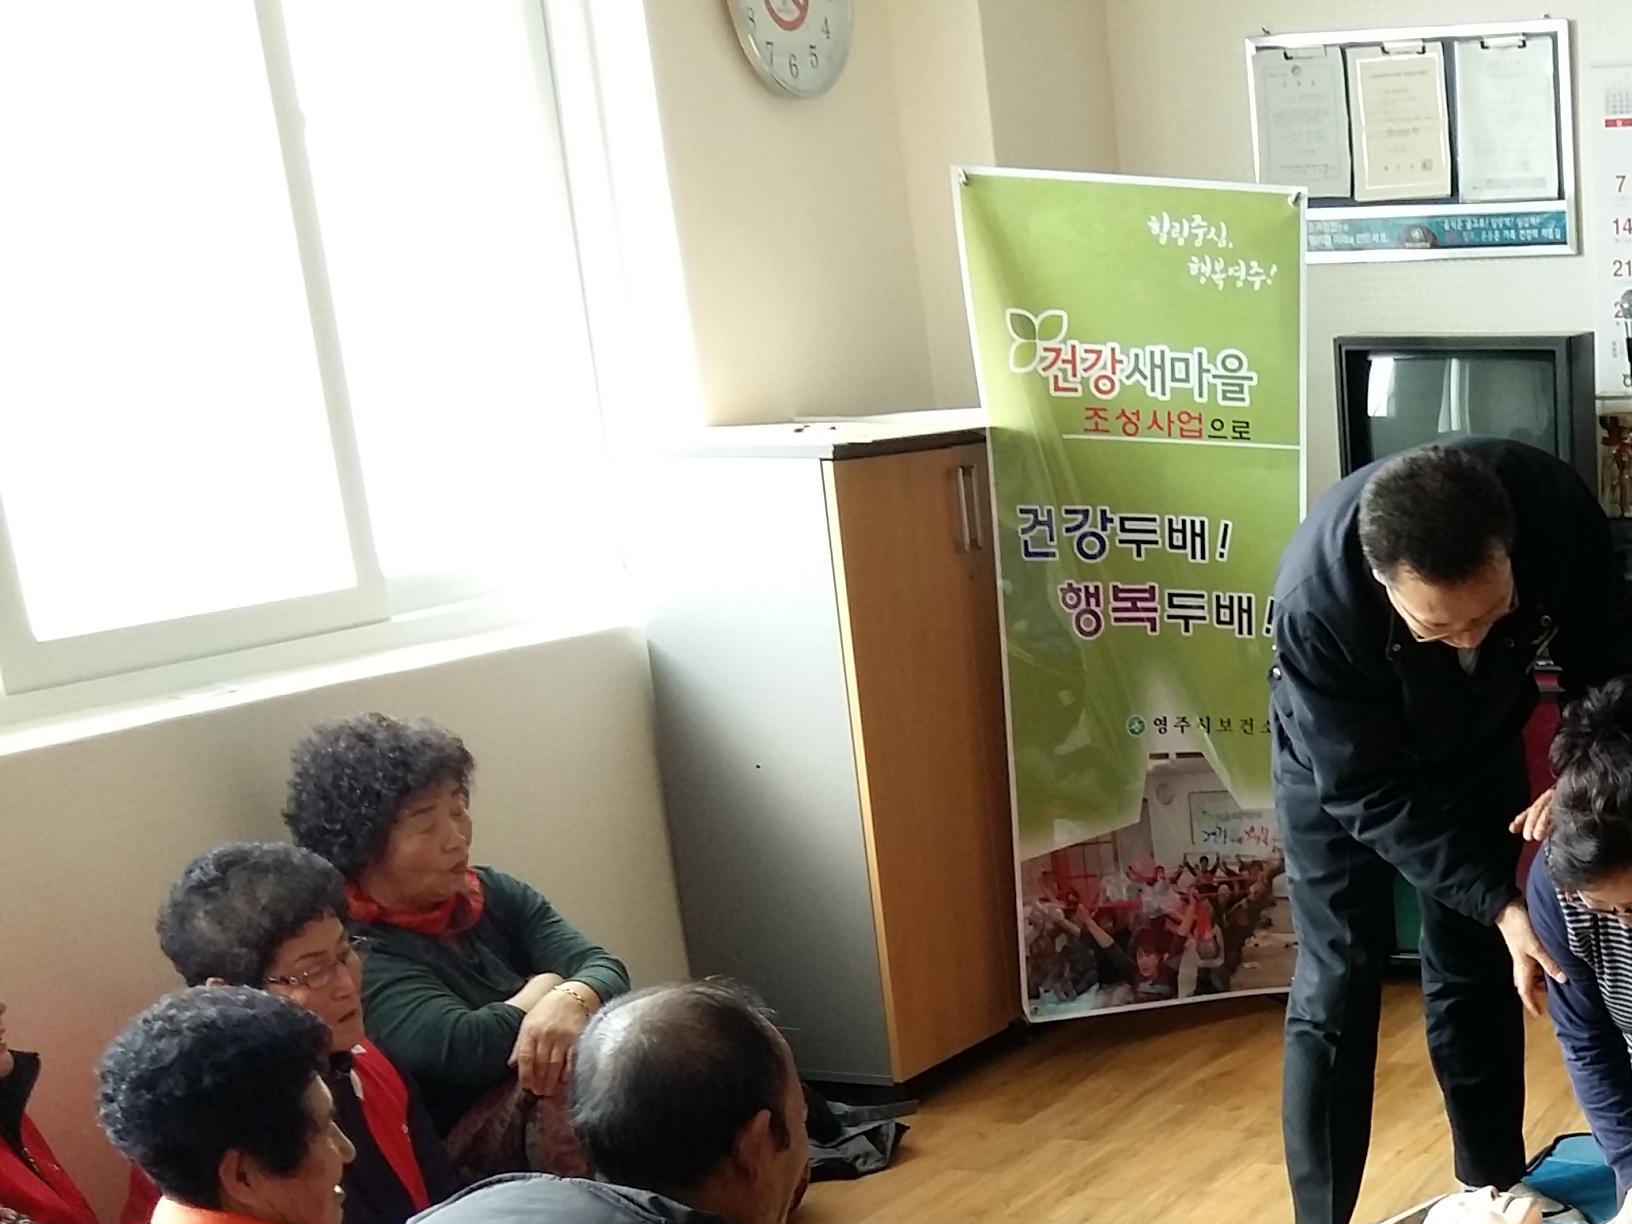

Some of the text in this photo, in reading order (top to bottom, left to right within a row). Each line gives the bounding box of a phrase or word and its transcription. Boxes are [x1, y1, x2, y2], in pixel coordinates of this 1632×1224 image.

[766, 41, 774, 67] 7
[789, 54, 799, 78] 6
[809, 44, 819, 69] 5
[1615, 175, 1626, 193] 7
[1613, 217, 1632, 235] 14
[1613, 259, 1632, 277] 21
[1041, 343, 1255, 403] 건강새마을
[1083, 406, 1251, 440] 조성사업으로
[1017, 506, 1232, 561] 건강두배!
[1059, 582, 1274, 637] 행복두배!
